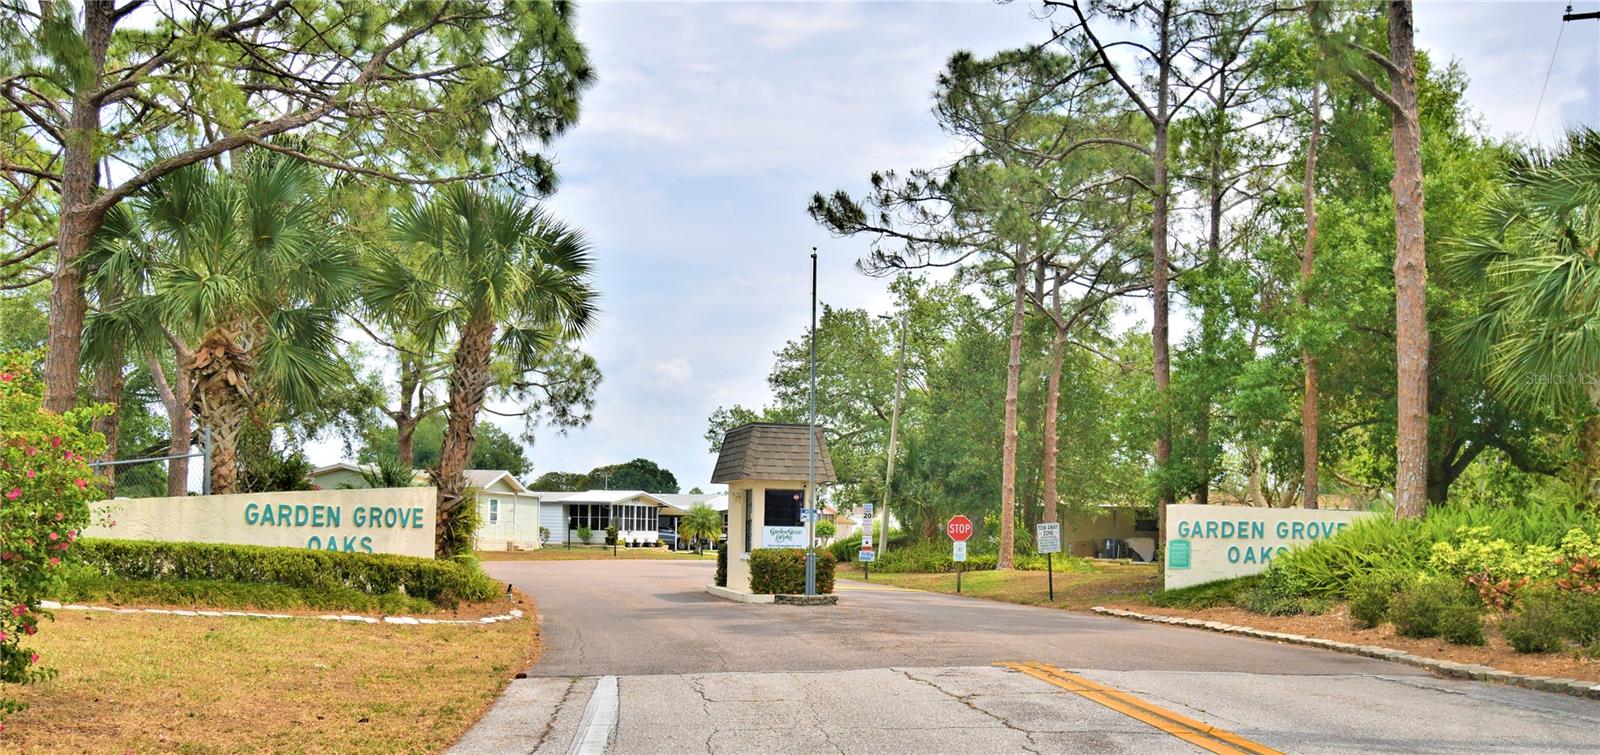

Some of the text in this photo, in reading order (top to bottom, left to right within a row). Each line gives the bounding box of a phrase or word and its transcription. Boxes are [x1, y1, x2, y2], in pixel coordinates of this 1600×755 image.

[244, 503, 424, 529] GARDEN GROVE
[949, 523, 971, 534] STOP
[1178, 520, 1265, 539] GARDEN
[307, 535, 373, 553] OAKS
